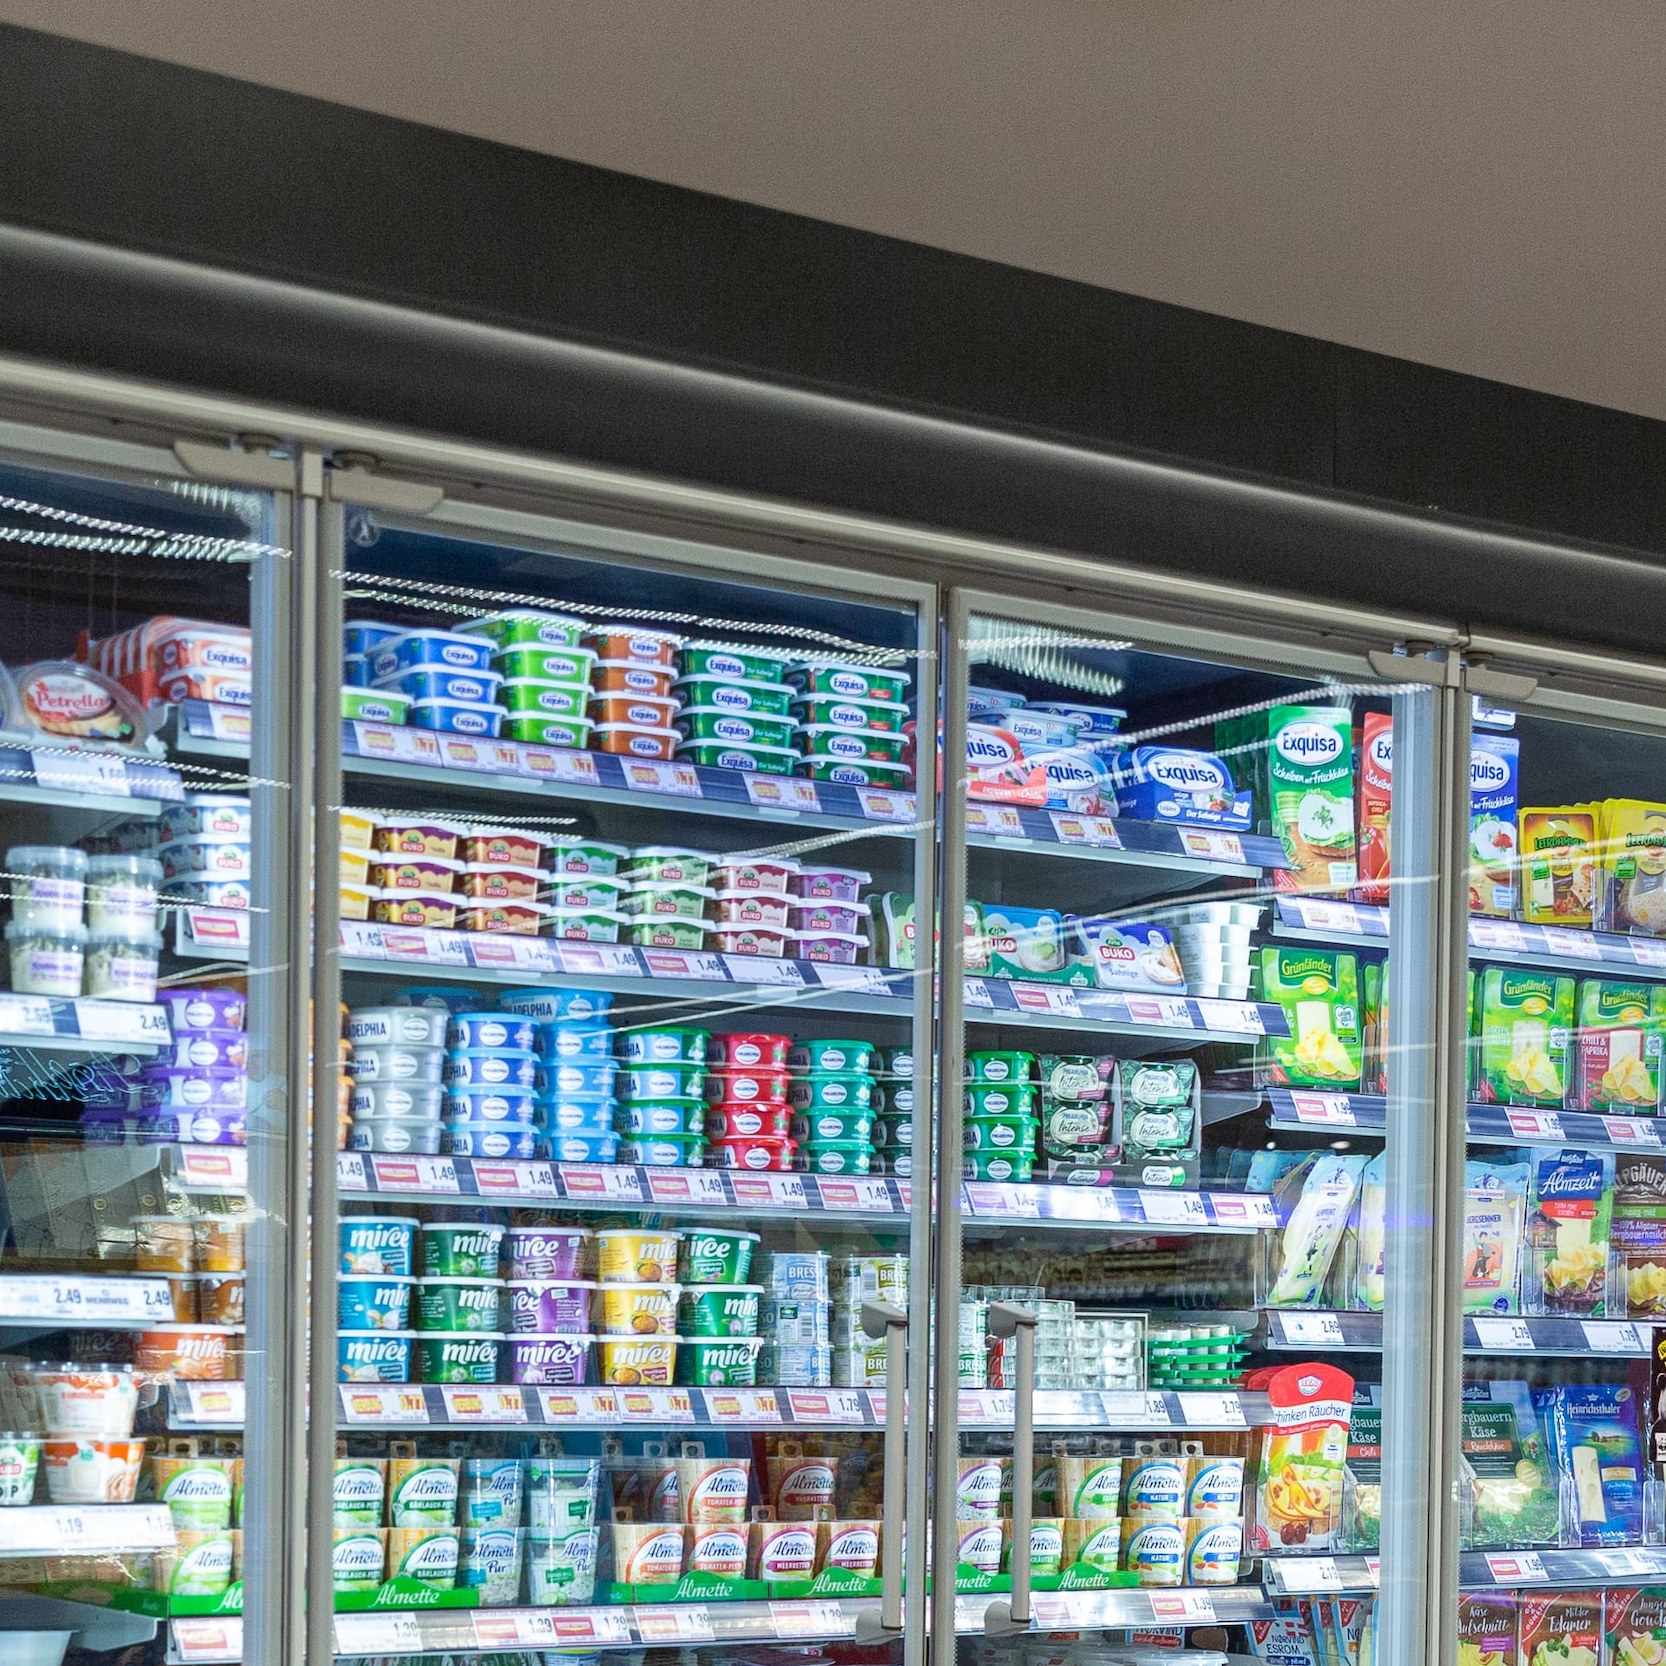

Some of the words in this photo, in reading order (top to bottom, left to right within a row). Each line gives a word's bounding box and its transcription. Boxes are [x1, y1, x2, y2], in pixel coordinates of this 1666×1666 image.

[206, 647, 249, 667] Exquisa
[444, 647, 478, 665] Exquisa
[710, 658, 745, 676] Exquisa
[34, 688, 108, 712] Petrella
[629, 705, 660, 722] Exquisa
[1283, 733, 1336, 756] Exquisa
[1154, 760, 1219, 786] Exquisa
[1273, 762, 1304, 783] Scheiben
[1312, 767, 1349, 785] Frischkäse
[401, 908, 425, 924] BUKO
[1101, 947, 1133, 960] BUKO
[1281, 958, 1334, 978] Grünländer
[1503, 980, 1553, 998] Grünländer
[1582, 1035, 1598, 1045] CHILI
[1582, 1045, 1609, 1057] PAPRIKA
[699, 1178, 722, 1194] 1.49
[1538, 1172, 1601, 1195] Almzeit
[350, 1225, 409, 1250] miree
[347, 1338, 406, 1363] miree
[516, 1339, 578, 1366] miree
[612, 1340, 671, 1364] miree
[1567, 1402, 1621, 1416] Heinrichsthaler
[1469, 1426, 1497, 1439] Käse
[168, 1479, 230, 1503] Almette
[1149, 1553, 1179, 1563] NATUR
[673, 1578, 733, 1600] Almette
[1057, 1569, 1111, 1591] Almette
[373, 1583, 440, 1607] Almette
[1549, 1611, 1592, 1633] Edamer
